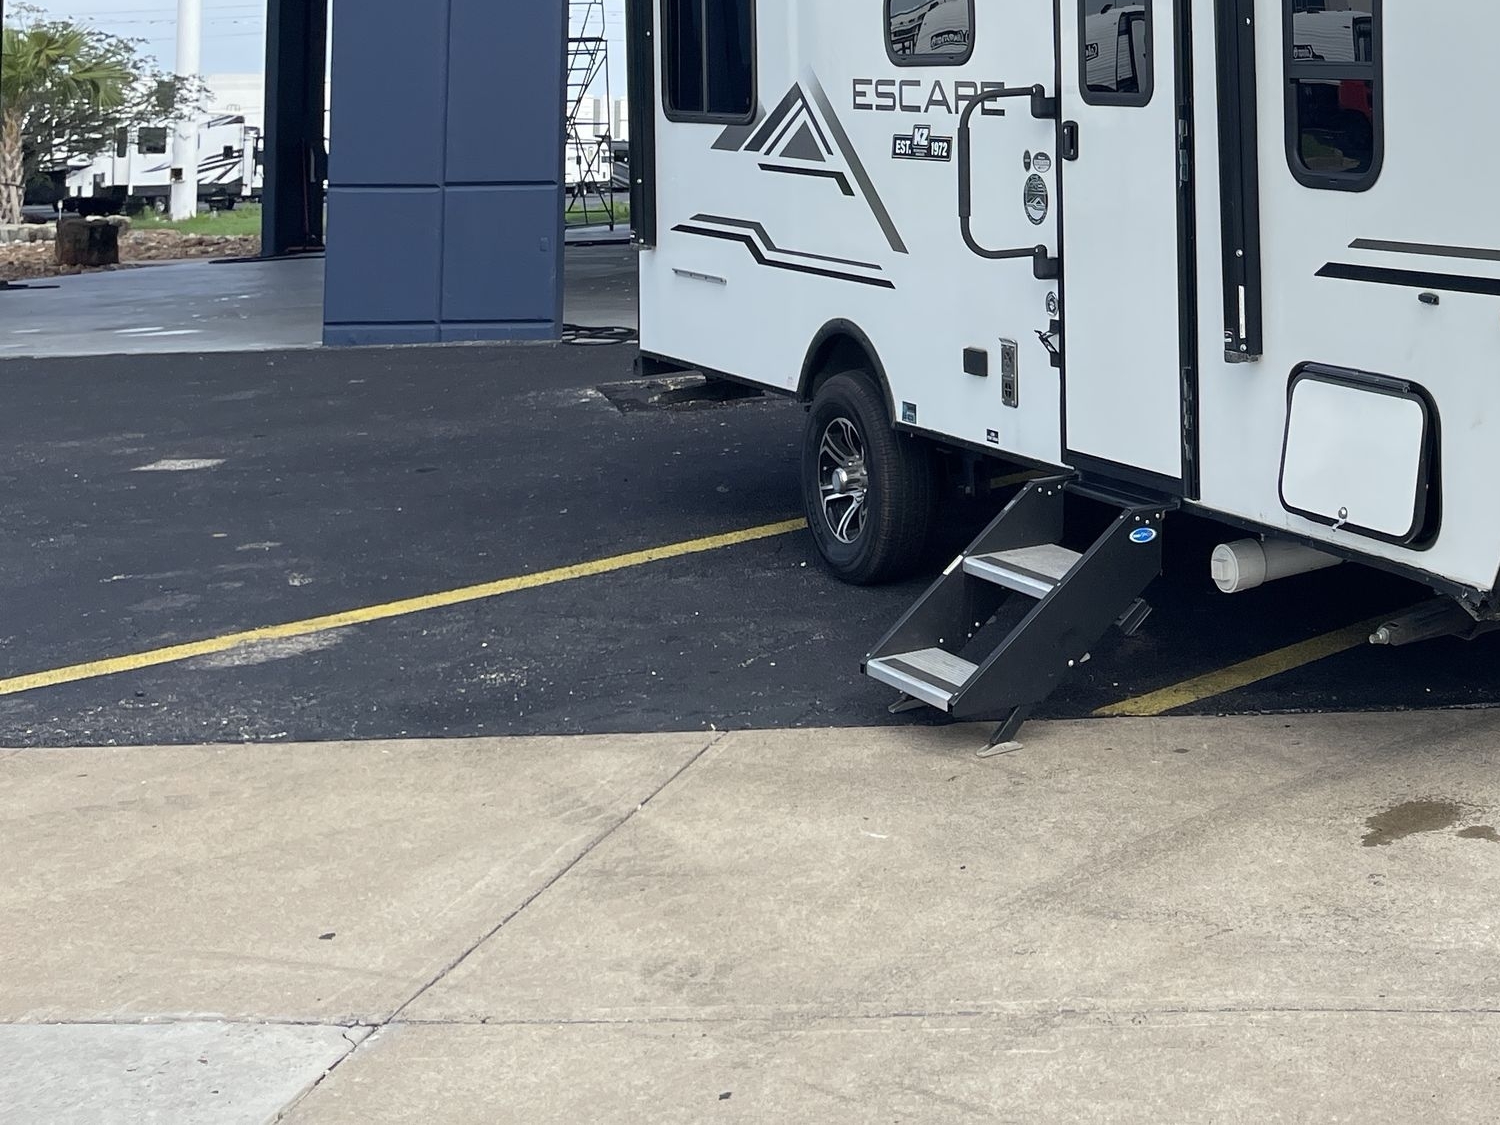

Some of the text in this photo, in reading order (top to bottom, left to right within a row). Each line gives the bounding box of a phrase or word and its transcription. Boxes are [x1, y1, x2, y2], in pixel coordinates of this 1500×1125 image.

[853, 78, 1005, 116] ESCAPE
[913, 128, 929, 146] KZ
[895, 139, 912, 154] EST.
[930, 141, 948, 156] 1972
